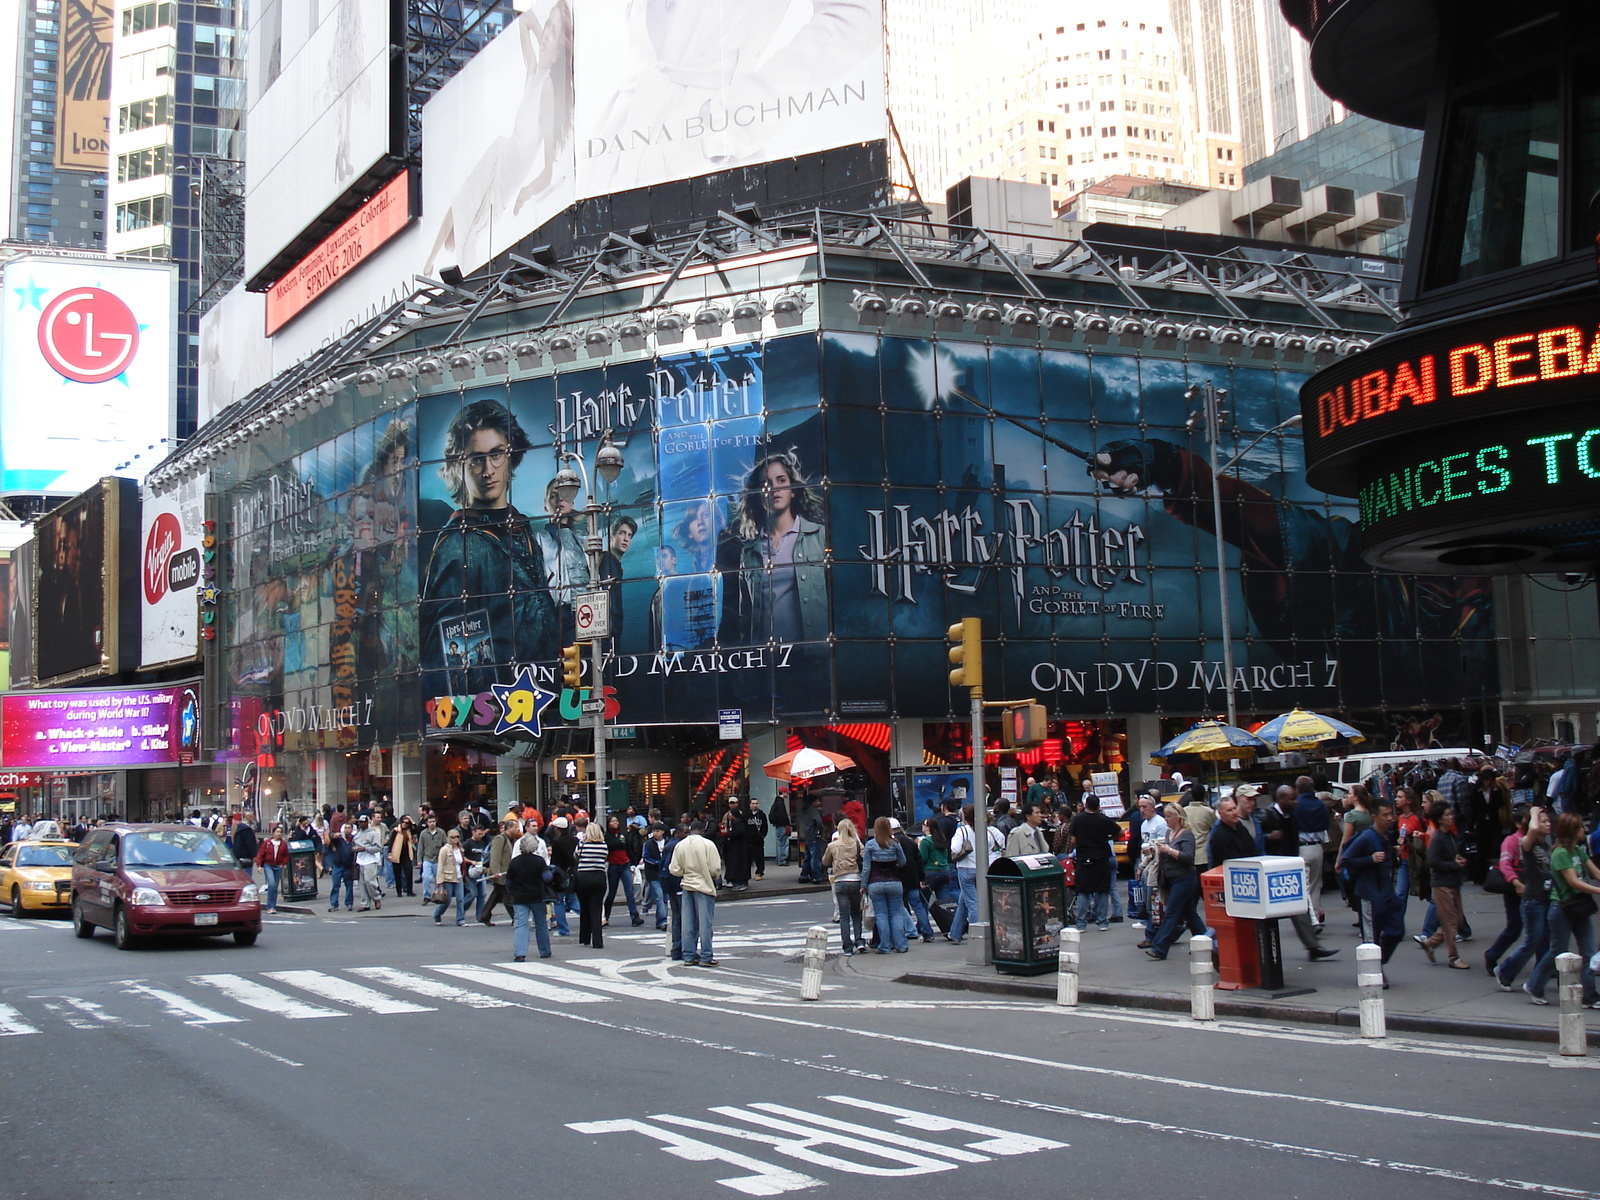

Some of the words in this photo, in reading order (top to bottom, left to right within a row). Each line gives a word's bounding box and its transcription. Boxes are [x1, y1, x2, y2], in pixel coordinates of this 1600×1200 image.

[587, 123, 673, 158] DANA
[685, 80, 866, 139] BUCHMAN
[276, 276, 298, 301] Modern,
[298, 252, 325, 281] Feminine,
[326, 222, 359, 256] Luxurious,
[306, 255, 339, 299] SPRING
[342, 236, 362, 269] 2006
[42, 290, 136, 380] LG
[1316, 355, 1437, 438] DUBAI
[549, 382, 646, 459] Harry
[646, 369, 757, 440] Potter
[664, 438, 720, 454] GOBLET
[733, 432, 773, 448] FIRE
[666, 431, 688, 440] AND
[148, 520, 175, 594] Virgin
[858, 504, 1004, 604] Harry
[1004, 499, 1145, 630] Potter
[171, 556, 197, 583] mobile
[1031, 586, 1061, 596] AND
[1061, 592, 1082, 600] THE
[1029, 598, 1100, 616] GOBLET
[1117, 601, 1164, 619] FIRE
[646, 647, 768, 678] MARCH
[776, 644, 793, 668] 7
[1030, 661, 1088, 696] ON
[1093, 658, 1178, 693] DVD
[1187, 659, 1315, 694] MARCH
[1324, 660, 1338, 688] 7
[29, 699, 53, 709] What
[53, 699, 69, 710] toy
[68, 700, 88, 708] was
[89, 696, 110, 707] used
[111, 696, 123, 708] by
[123, 696, 137, 705] the
[138, 695, 151, 705] U.S.
[152, 694, 173, 705] military
[425, 693, 495, 729] TOYS
[559, 686, 620, 720] US
[66, 710, 97, 721] during
[97, 708, 124, 719] World
[124, 708, 140, 718] War
[276, 706, 306, 735] DVD
[308, 701, 360, 733] MARCH
[36, 731, 47, 740] a.
[48, 726, 124, 739] Whack-a-Mole
[131, 725, 141, 737] b.
[620, 728, 628, 737] 44
[140, 739, 150, 750] d.
[150, 740, 169, 750] Kites
[1240, 873, 1256, 885] USA
[1279, 874, 1299, 886] USA
[1232, 884, 1257, 897] TODAY
[1269, 884, 1300, 897] TODAY
